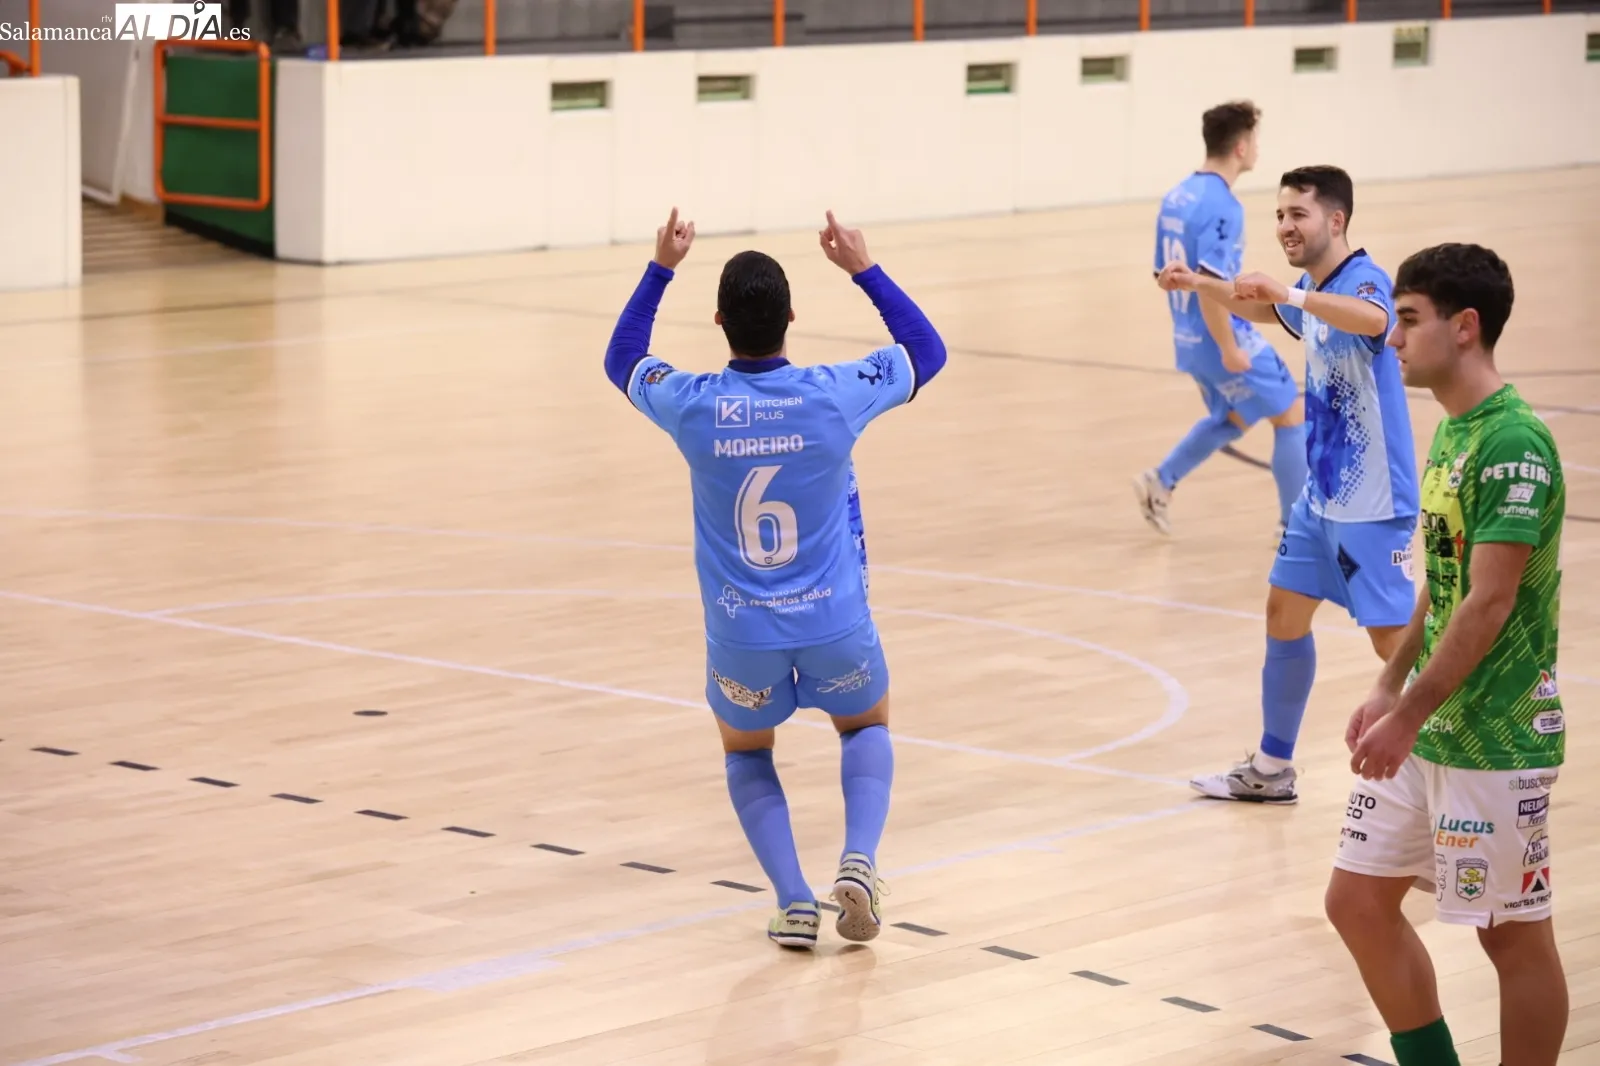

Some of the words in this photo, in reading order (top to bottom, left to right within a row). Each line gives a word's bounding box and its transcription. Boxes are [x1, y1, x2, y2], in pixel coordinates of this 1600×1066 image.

[754, 396, 803, 408] KITCHEN
[754, 410, 785, 421] PLUS
[713, 434, 805, 458] MOREIRO
[734, 464, 798, 571] 6
[750, 596, 800, 608] recoletas
[802, 587, 832, 602] salud
[1438, 813, 1495, 834] Lucus
[1436, 830, 1479, 848] Ener
